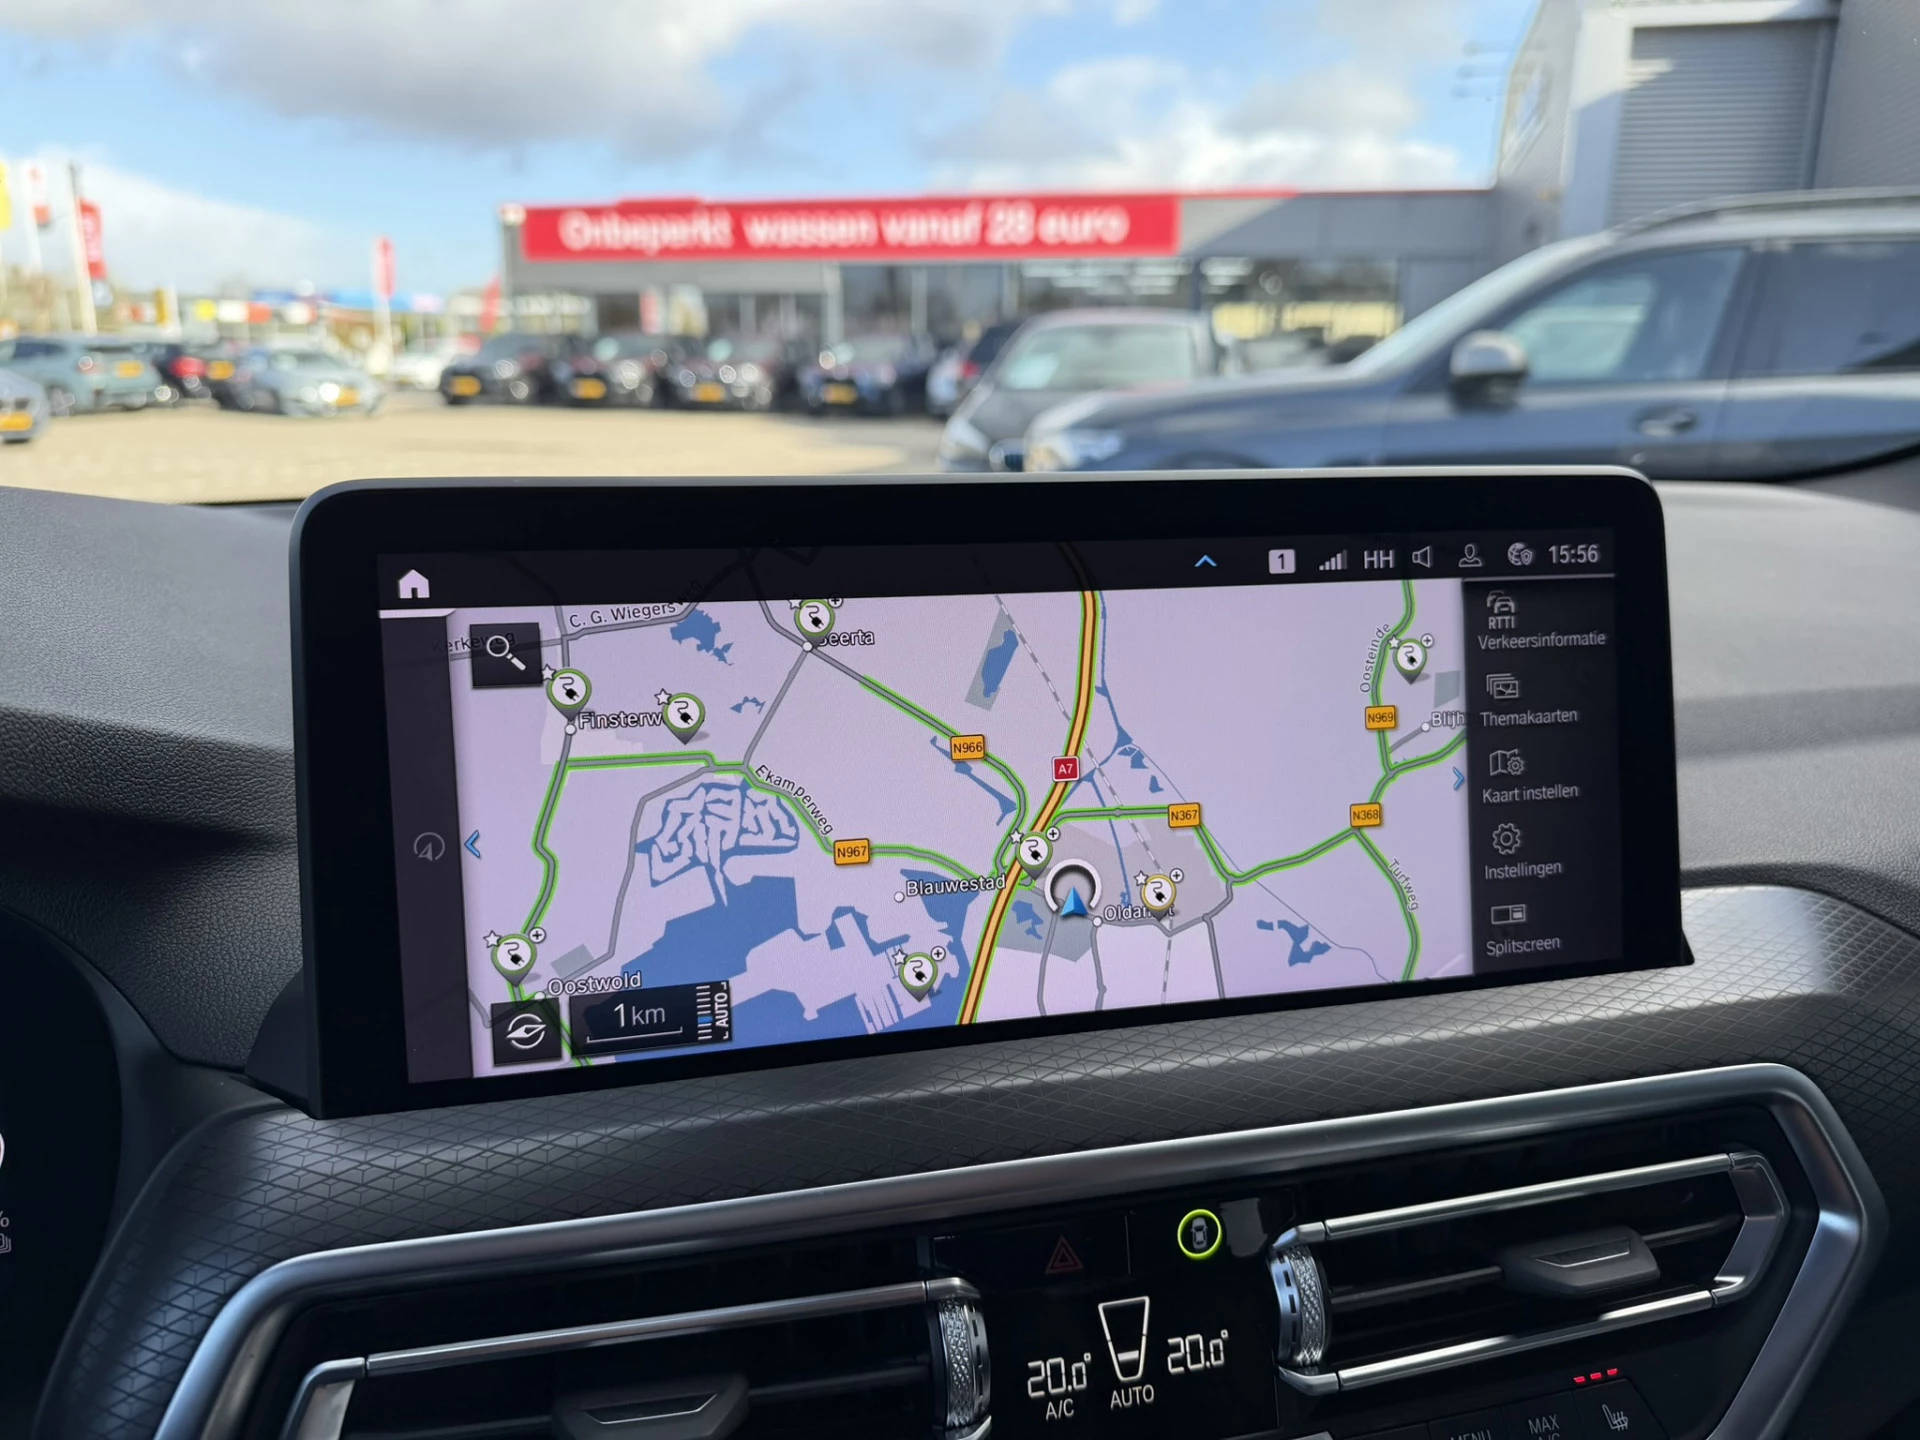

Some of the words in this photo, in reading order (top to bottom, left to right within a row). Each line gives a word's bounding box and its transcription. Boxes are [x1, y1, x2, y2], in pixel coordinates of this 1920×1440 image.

[743, 210, 878, 247] wassen
[881, 202, 984, 246] vanaf
[1038, 207, 1129, 245] euro
[1364, 550, 1395, 570] HH
[1549, 543, 1599, 564] 15:56
[569, 613, 586, 628] C.
[590, 609, 608, 625] G.
[610, 603, 676, 623] Wiegers
[1488, 616, 1515, 630] RTTI
[818, 631, 875, 647] eerta
[1478, 631, 1606, 650] Verkeersinformatie
[1359, 623, 1391, 693] Oosteinde
[1367, 713, 1394, 726] N969
[1480, 708, 1578, 727] Themakaarten
[953, 741, 983, 756] N966
[1058, 763, 1073, 775] A7
[754, 763, 834, 836] Ekamperweg
[1482, 785, 1520, 803] Kaart
[1522, 783, 1579, 801] instellen
[1170, 808, 1198, 823] N367
[1352, 809, 1379, 821] N368
[837, 844, 867, 859] N967
[1485, 861, 1562, 880] Instellingen
[905, 875, 1006, 896] Blauwestad
[1389, 858, 1419, 912] Turfweg
[1486, 936, 1561, 956] Splitscreen
[548, 972, 642, 996] Oostwold
[714, 992, 729, 1029] AUTO
[1110, 1384, 1155, 1409] AUTO
[1045, 1398, 1074, 1421] A/C
[1528, 1414, 1559, 1434] MAX
